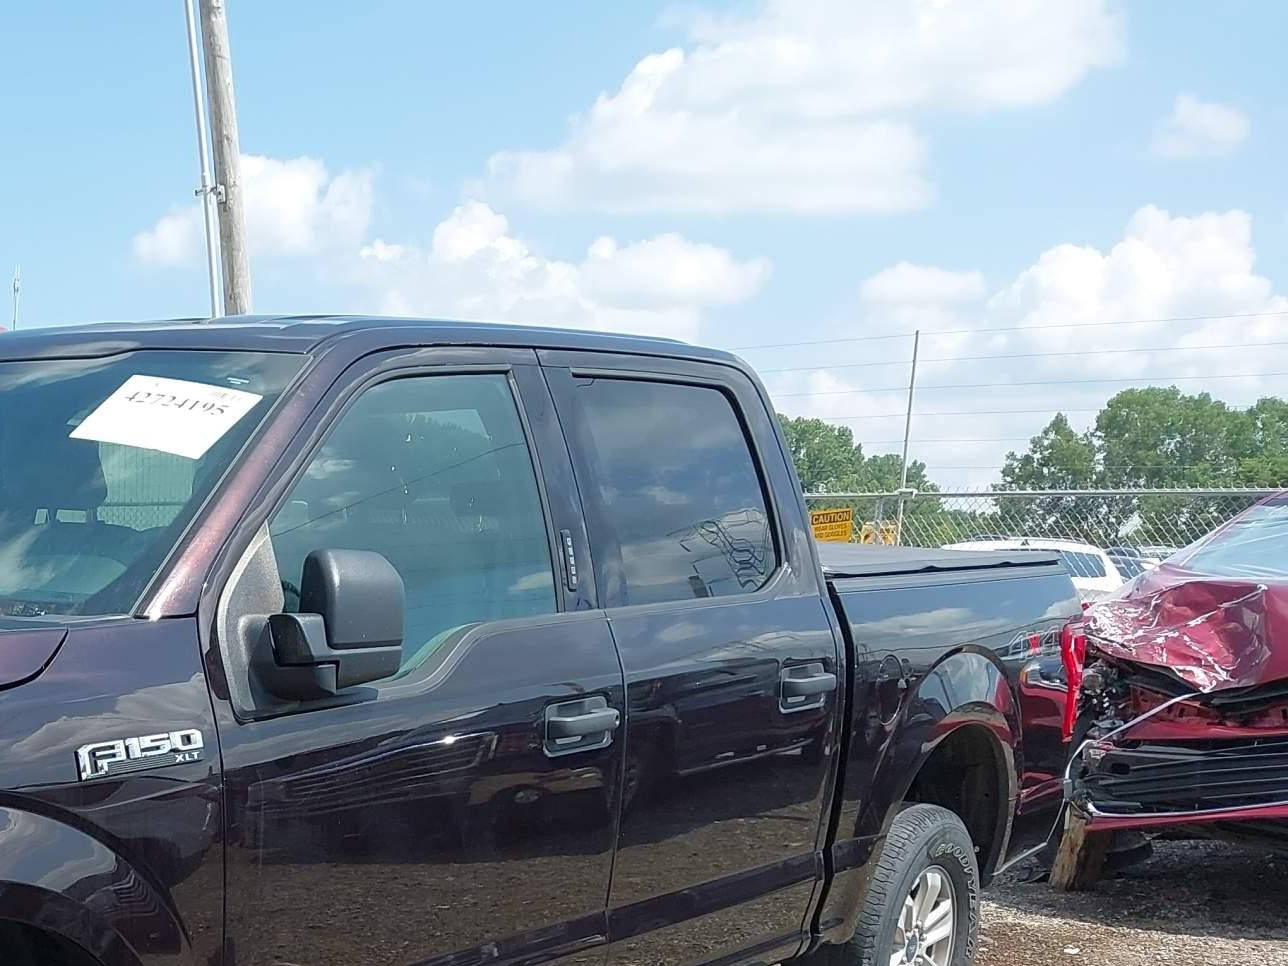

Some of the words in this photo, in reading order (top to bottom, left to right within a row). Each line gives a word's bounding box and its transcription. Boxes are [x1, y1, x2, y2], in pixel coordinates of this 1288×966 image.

[125, 391, 230, 416] 42724195
[813, 512, 850, 525] CAUTION
[174, 751, 199, 763] XLT
